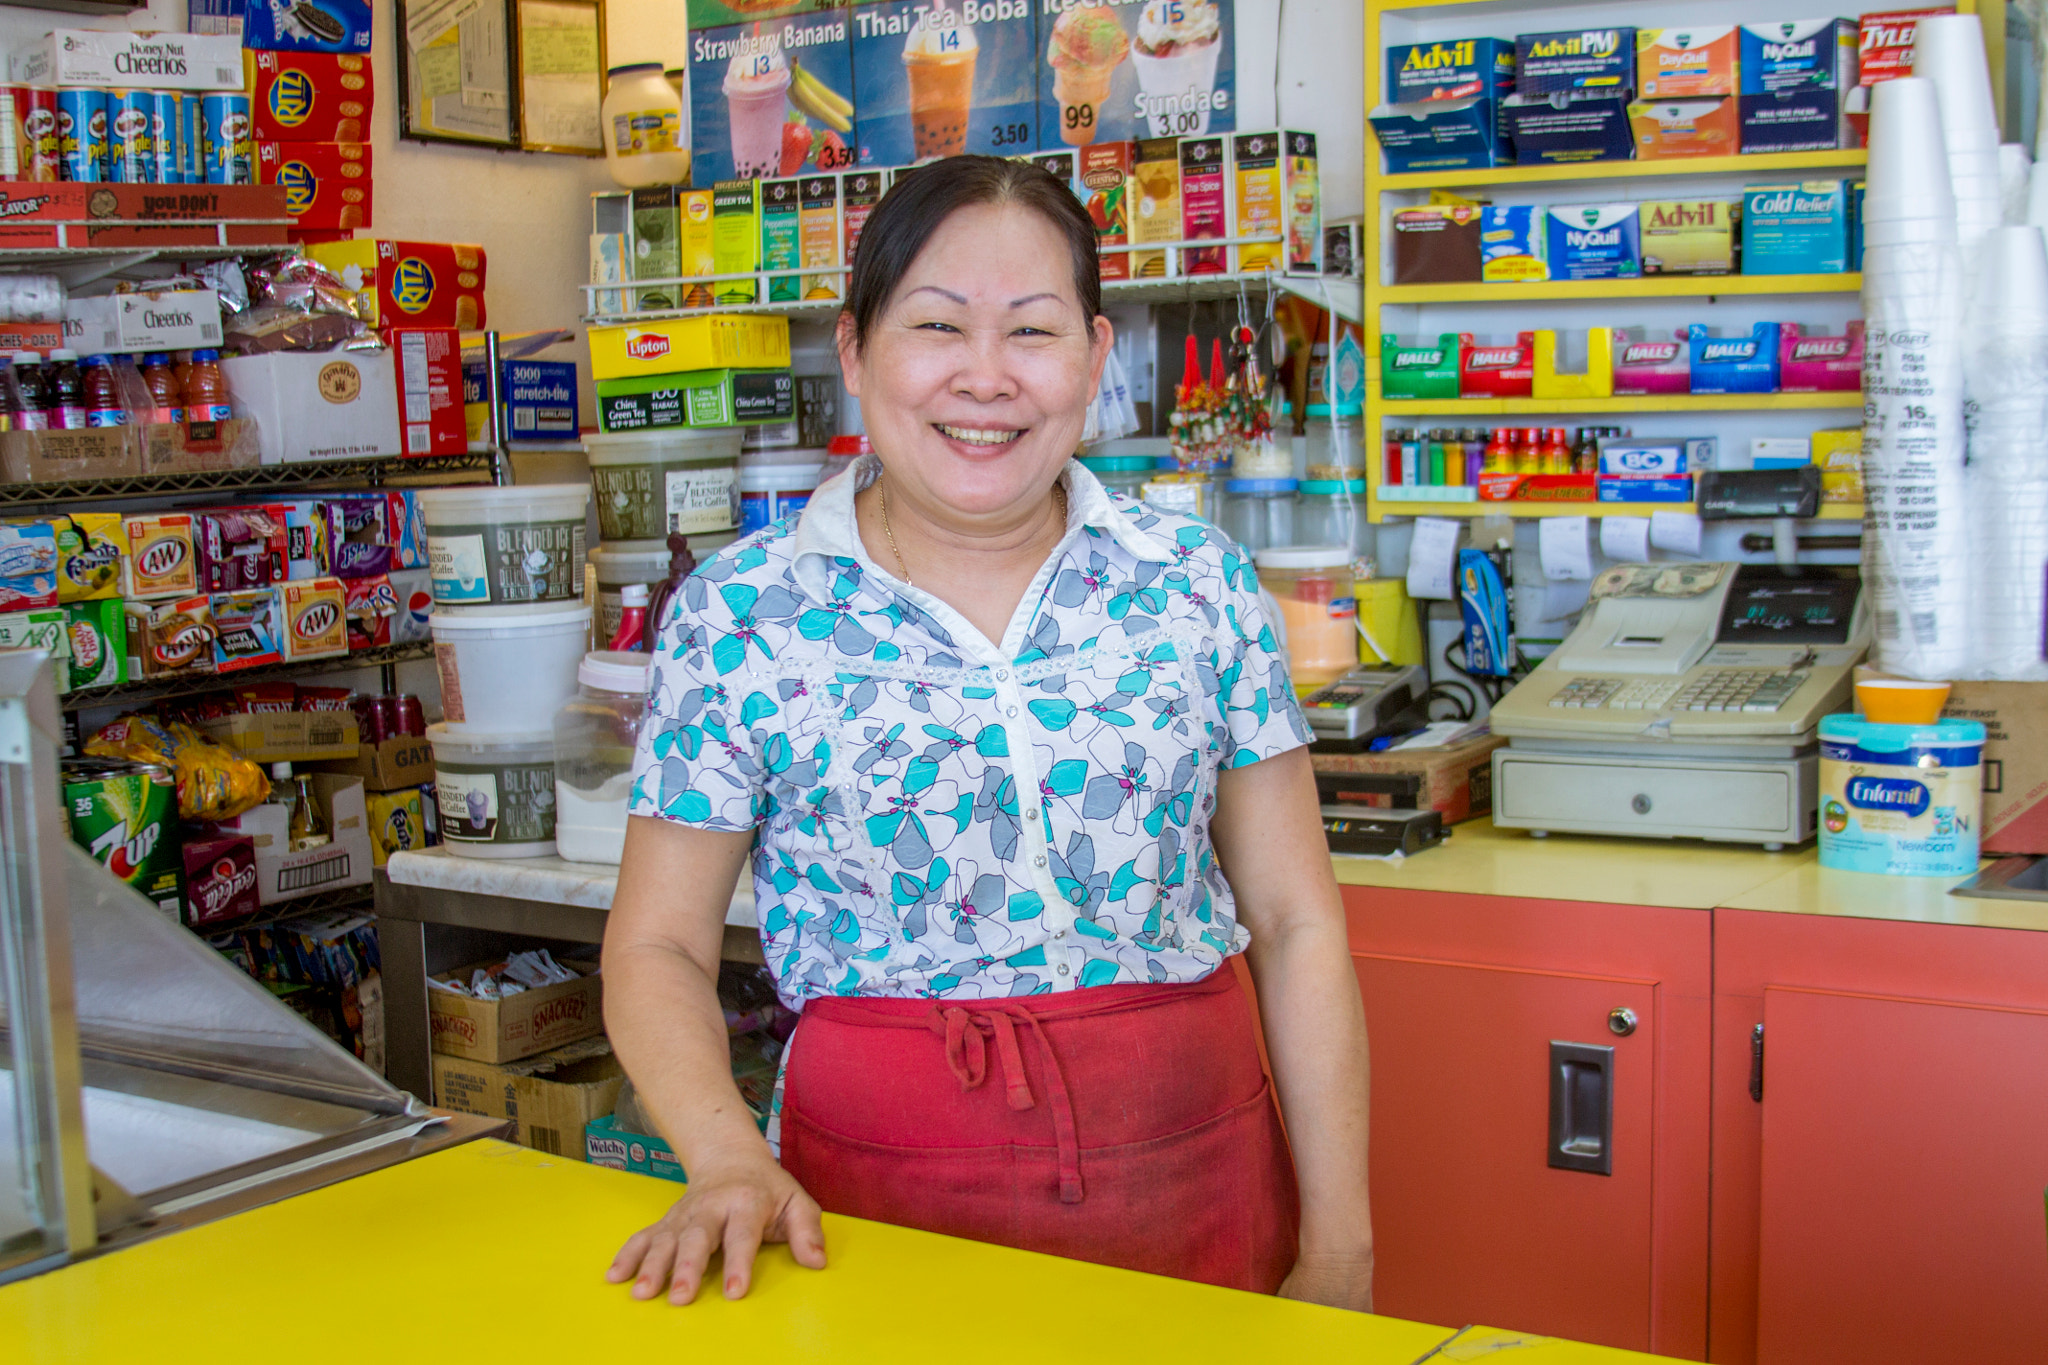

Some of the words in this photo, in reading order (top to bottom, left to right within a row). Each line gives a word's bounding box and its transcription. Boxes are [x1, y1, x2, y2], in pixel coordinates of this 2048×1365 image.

[269, 0, 284, 41] OREO
[855, 11, 909, 38] Thai
[913, 5, 956, 31] Tea
[962, 0, 1028, 25] Boba
[1163, 2, 1186, 25] 15
[130, 42, 164, 57] Honey
[165, 44, 185, 56] Nut
[695, 32, 780, 62] Strawberry
[784, 22, 845, 49] Banana
[940, 30, 959, 52] 14
[1528, 38, 1581, 58] Advil
[1581, 30, 1614, 54] PM
[1401, 40, 1477, 71] Advil
[1659, 50, 1709, 68] DayQuil
[1762, 40, 1816, 62] NyQuil
[115, 52, 187, 75] Cheerios
[259, 53, 271, 70] 15
[754, 55, 770, 76] 13
[276, 73, 308, 126] RITZ
[1133, 86, 1228, 119] Sundae
[1065, 104, 1093, 129] 99
[1158, 111, 1200, 137] 3.00
[991, 123, 1028, 146] 3.50
[112, 134, 152, 165] Pringles
[261, 144, 273, 163] 15
[823, 145, 856, 169] 3.50
[714, 180, 752, 191] BIGELOW
[1184, 182, 1199, 193] Chai
[1199, 181, 1220, 192] Spice
[1244, 174, 1270, 184] Lemon
[1246, 184, 1270, 196] Ginger
[179, 192, 219, 212] DON'T
[714, 197, 736, 206] GREEN
[736, 194, 752, 205] TEA
[1751, 191, 1795, 214] Cold
[1794, 196, 1835, 213] Relief
[1649, 202, 1716, 227] Advil
[764, 218, 797, 230] Peppermint
[1566, 228, 1622, 250] NyQuil
[380, 242, 392, 258] 15
[398, 260, 429, 312] RITZ
[144, 310, 194, 329] Cheerios
[32, 334, 58, 347] OATS
[629, 340, 668, 357] Lipton
[1395, 349, 1444, 367] HALLS
[1472, 349, 1521, 366] HALLS
[1625, 344, 1676, 362] HALLS
[1704, 341, 1757, 360] HALLS
[1795, 341, 1848, 359] HALLS
[513, 366, 541, 381] 3000
[1901, 363, 1925, 373] CUPS
[513, 384, 570, 402] stretch-tite
[651, 386, 678, 400] 100
[774, 377, 791, 391] 100
[614, 400, 637, 411] China
[651, 400, 679, 411] TEABAGS
[735, 397, 750, 408] China
[751, 396, 766, 407] Green
[766, 395, 776, 406] Tea
[608, 411, 632, 421] Green
[632, 408, 646, 418] Tea
[1903, 405, 1926, 420] 16
[1625, 452, 1659, 469] BC
[690, 486, 729, 499] BLENDED
[1553, 486, 1593, 499] ENERGY
[1898, 497, 1909, 505] 25
[1910, 496, 1936, 505] CUPS
[691, 498, 703, 509] Ice
[704, 497, 728, 509] Coffee
[1704, 501, 1736, 510] CASIO
[1896, 522, 1908, 531] 25
[496, 526, 551, 553] BLENDED
[555, 526, 570, 551] ICE
[148, 541, 179, 575] A&W
[128, 616, 138, 628] 12
[303, 602, 333, 637] A&W
[73, 620, 96, 668] CANADA
[85, 630, 98, 653] DRY
[1950, 709, 1968, 718] DRY
[1970, 708, 1998, 718] YEAST
[1852, 780, 1922, 805] Enfamil
[75, 797, 93, 812] 36
[446, 802, 466, 815] Coffee
[1955, 815, 1969, 833] N
[91, 818, 161, 868] 7UP
[1896, 839, 1955, 853] Newborn
[534, 995, 588, 1036] SNACKERZ
[431, 1016, 477, 1043] SNACKERZ
[444, 1071, 455, 1080] LOS
[455, 1072, 478, 1084] ANGELES,
[445, 1079, 456, 1088] SAN
[456, 1081, 484, 1094] FRANCISCO
[445, 1088, 467, 1099] HOUSTON
[445, 1096, 457, 1105] NEW
[458, 1098, 470, 1108] YORK
